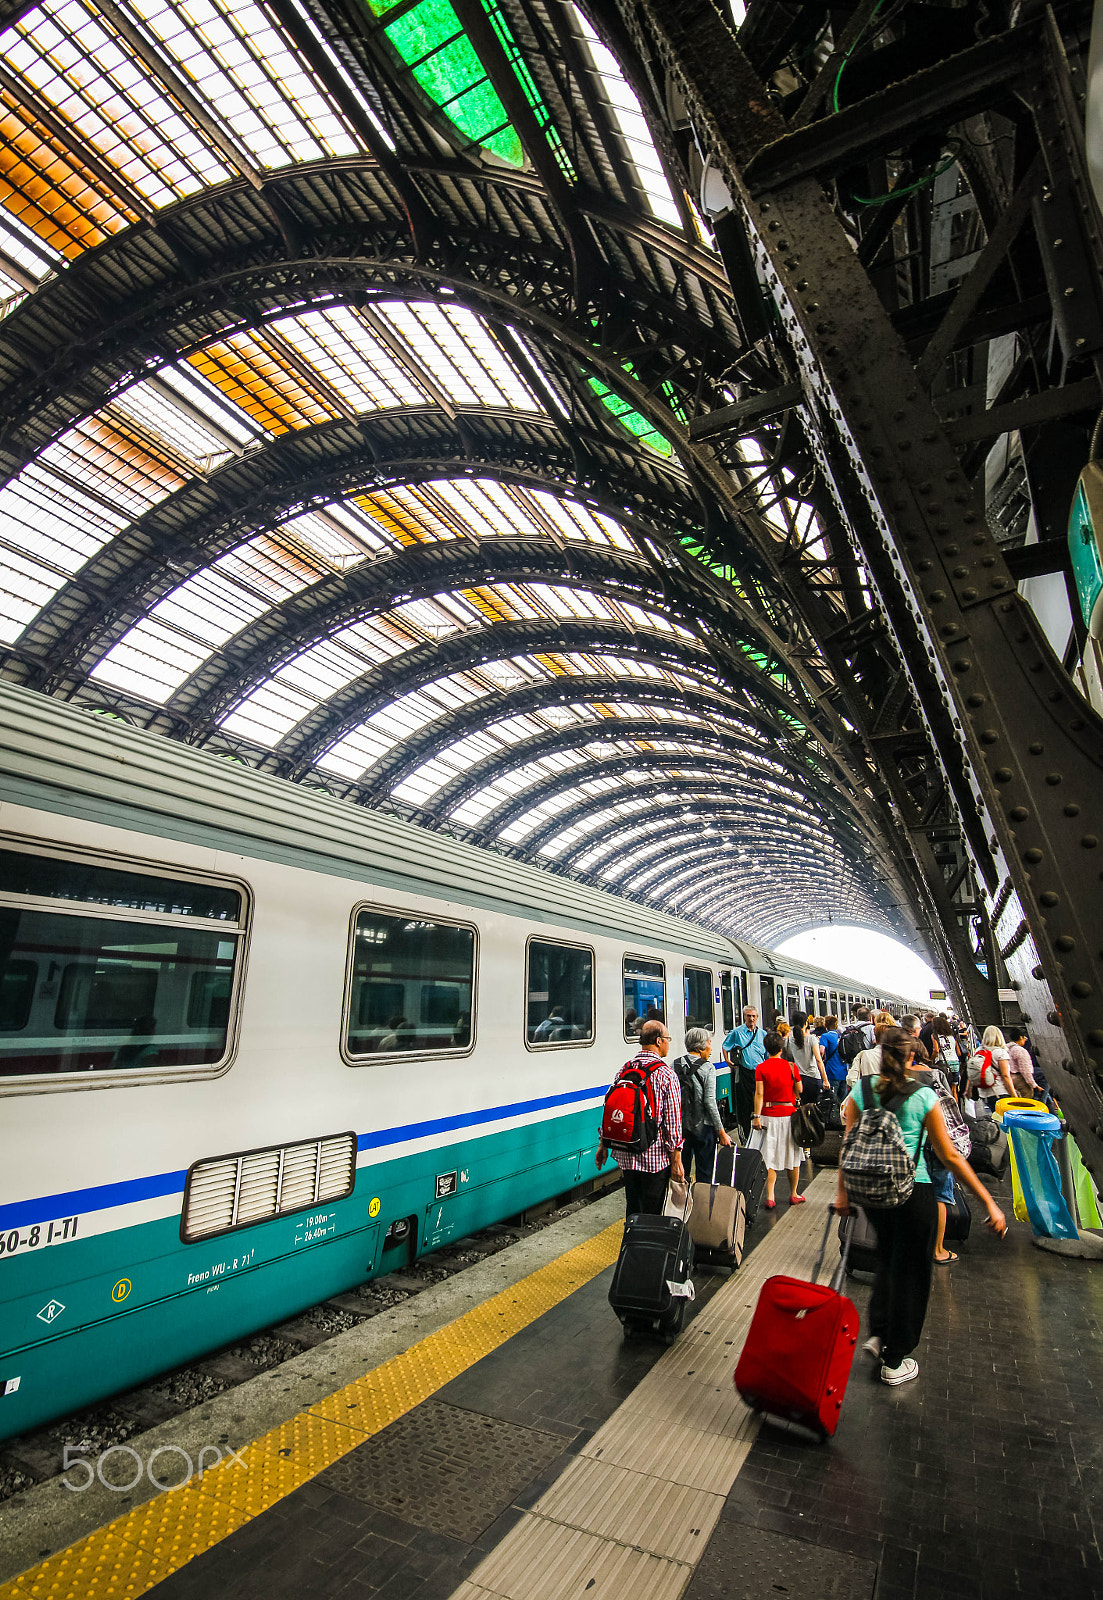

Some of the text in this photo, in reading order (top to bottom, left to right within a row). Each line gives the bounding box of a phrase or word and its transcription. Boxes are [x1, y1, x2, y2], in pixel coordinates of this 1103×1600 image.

[306, 1214, 328, 1228] 19.00m
[47, 1216, 79, 1244] I-TI
[304, 1227, 327, 1242] 26.40m
[187, 1271, 210, 1286] Freno
[211, 1262, 226, 1277] WU
[232, 1258, 238, 1270] R
[117, 1283, 126, 1298] D
[47, 1304, 56, 1319] R
